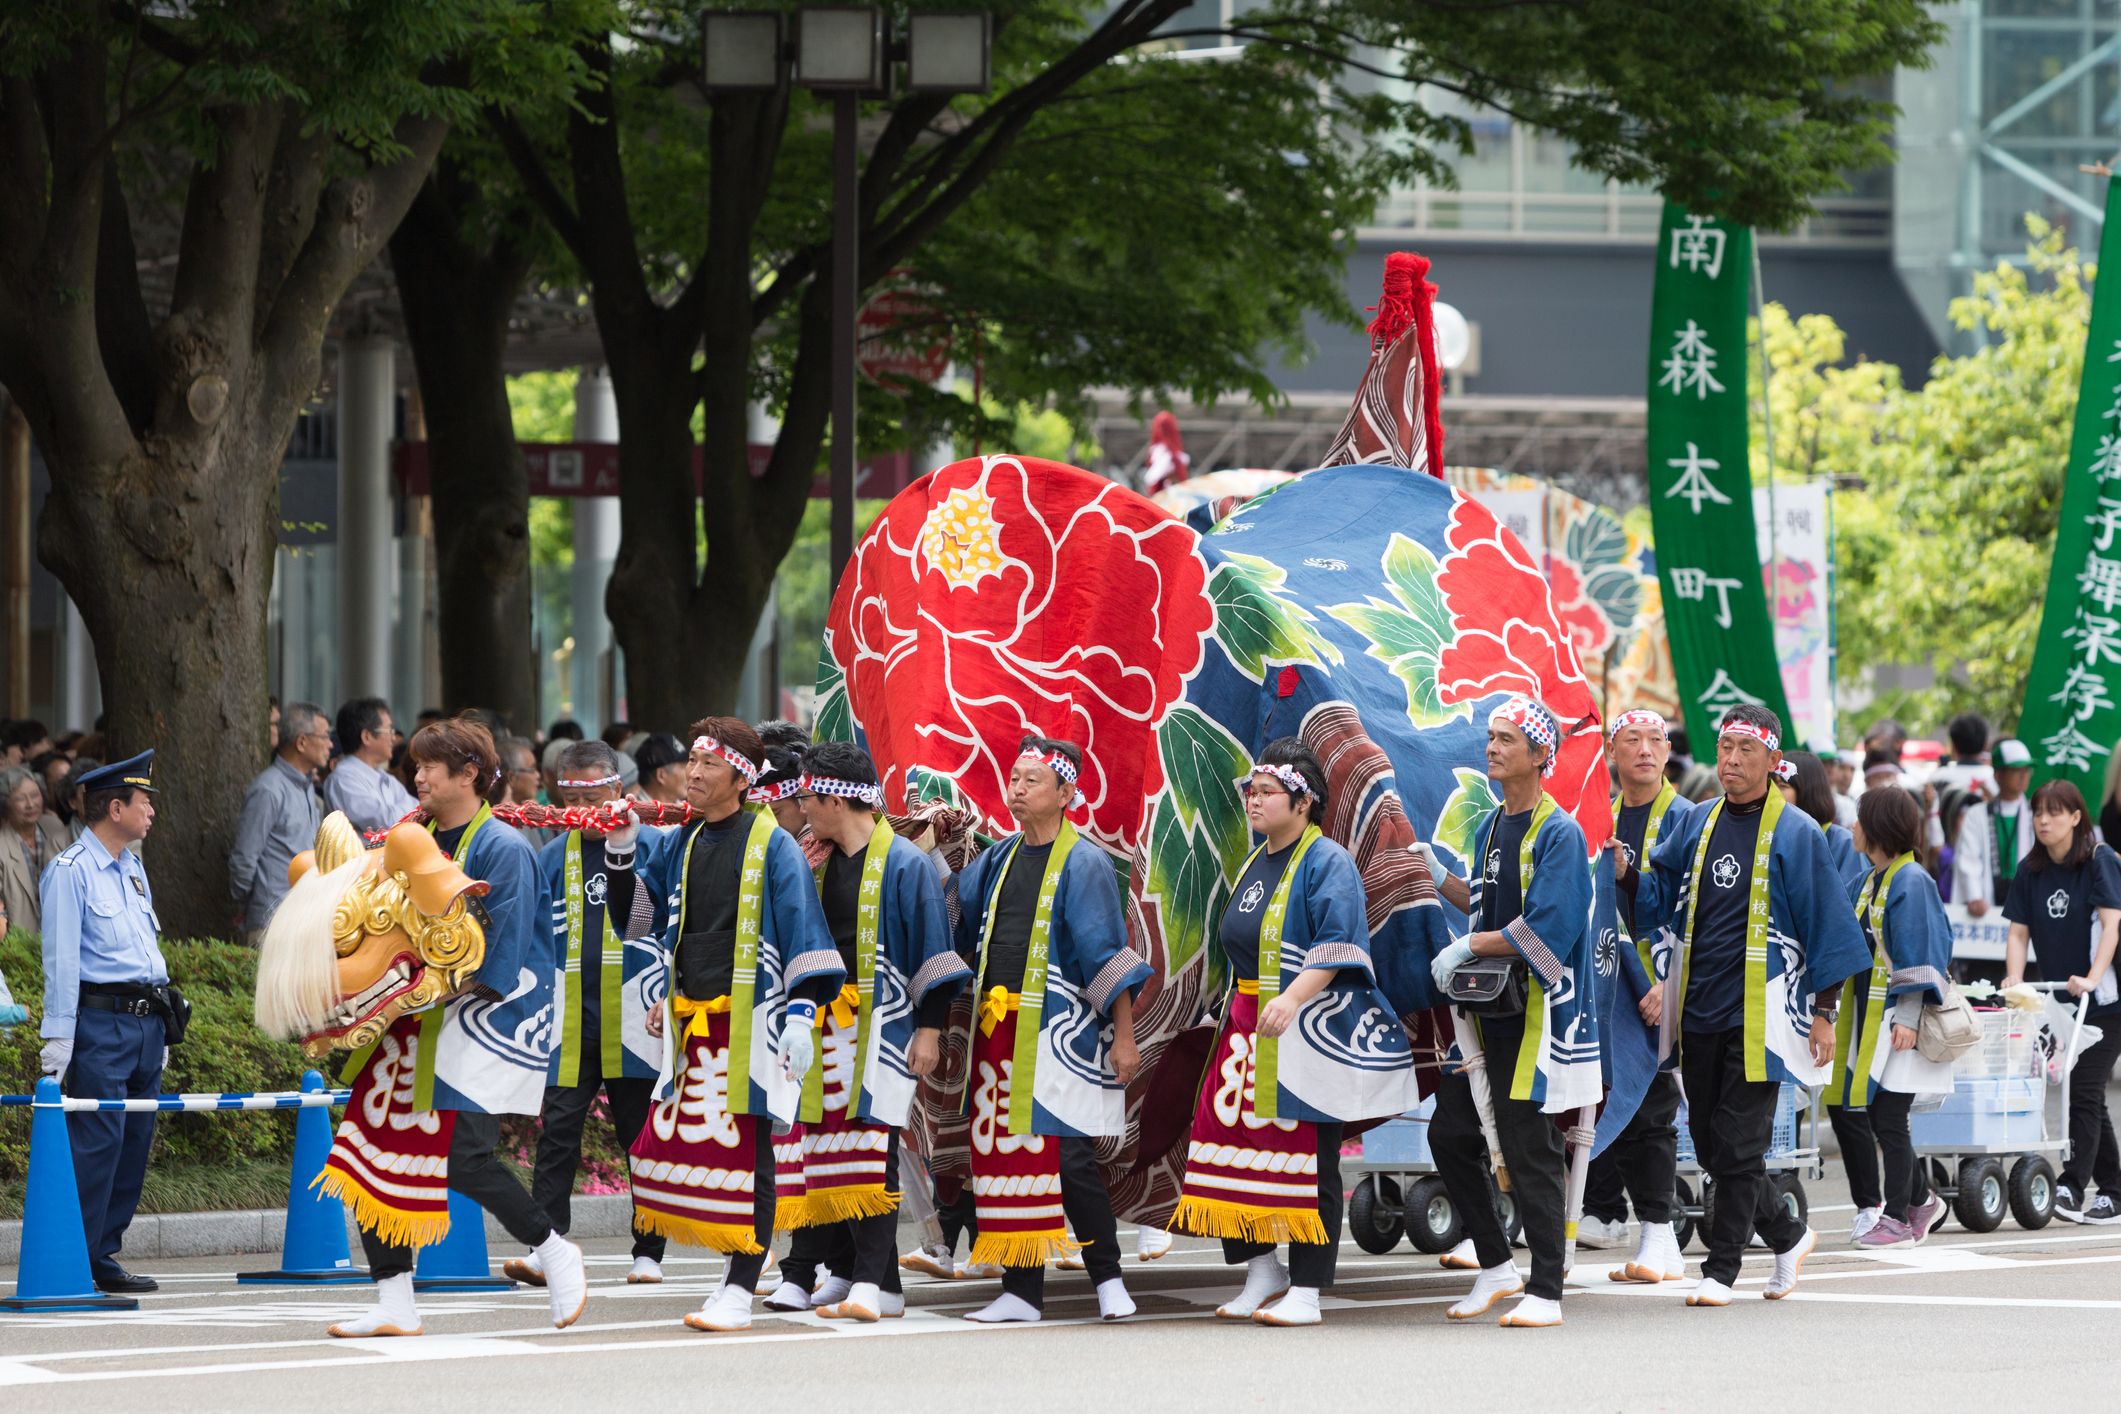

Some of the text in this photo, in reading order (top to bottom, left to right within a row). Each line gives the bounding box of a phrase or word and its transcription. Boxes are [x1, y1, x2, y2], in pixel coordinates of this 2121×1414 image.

[1659, 214, 1766, 731] 南森本町会
[566, 850, 581, 950] 獅子舞保存会
[738, 844, 765, 960] 浅野町校下
[860, 856, 883, 969] 浅野町校下
[1028, 871, 1061, 983] 浅野町校下
[1750, 831, 1774, 939] 浅野町校下
